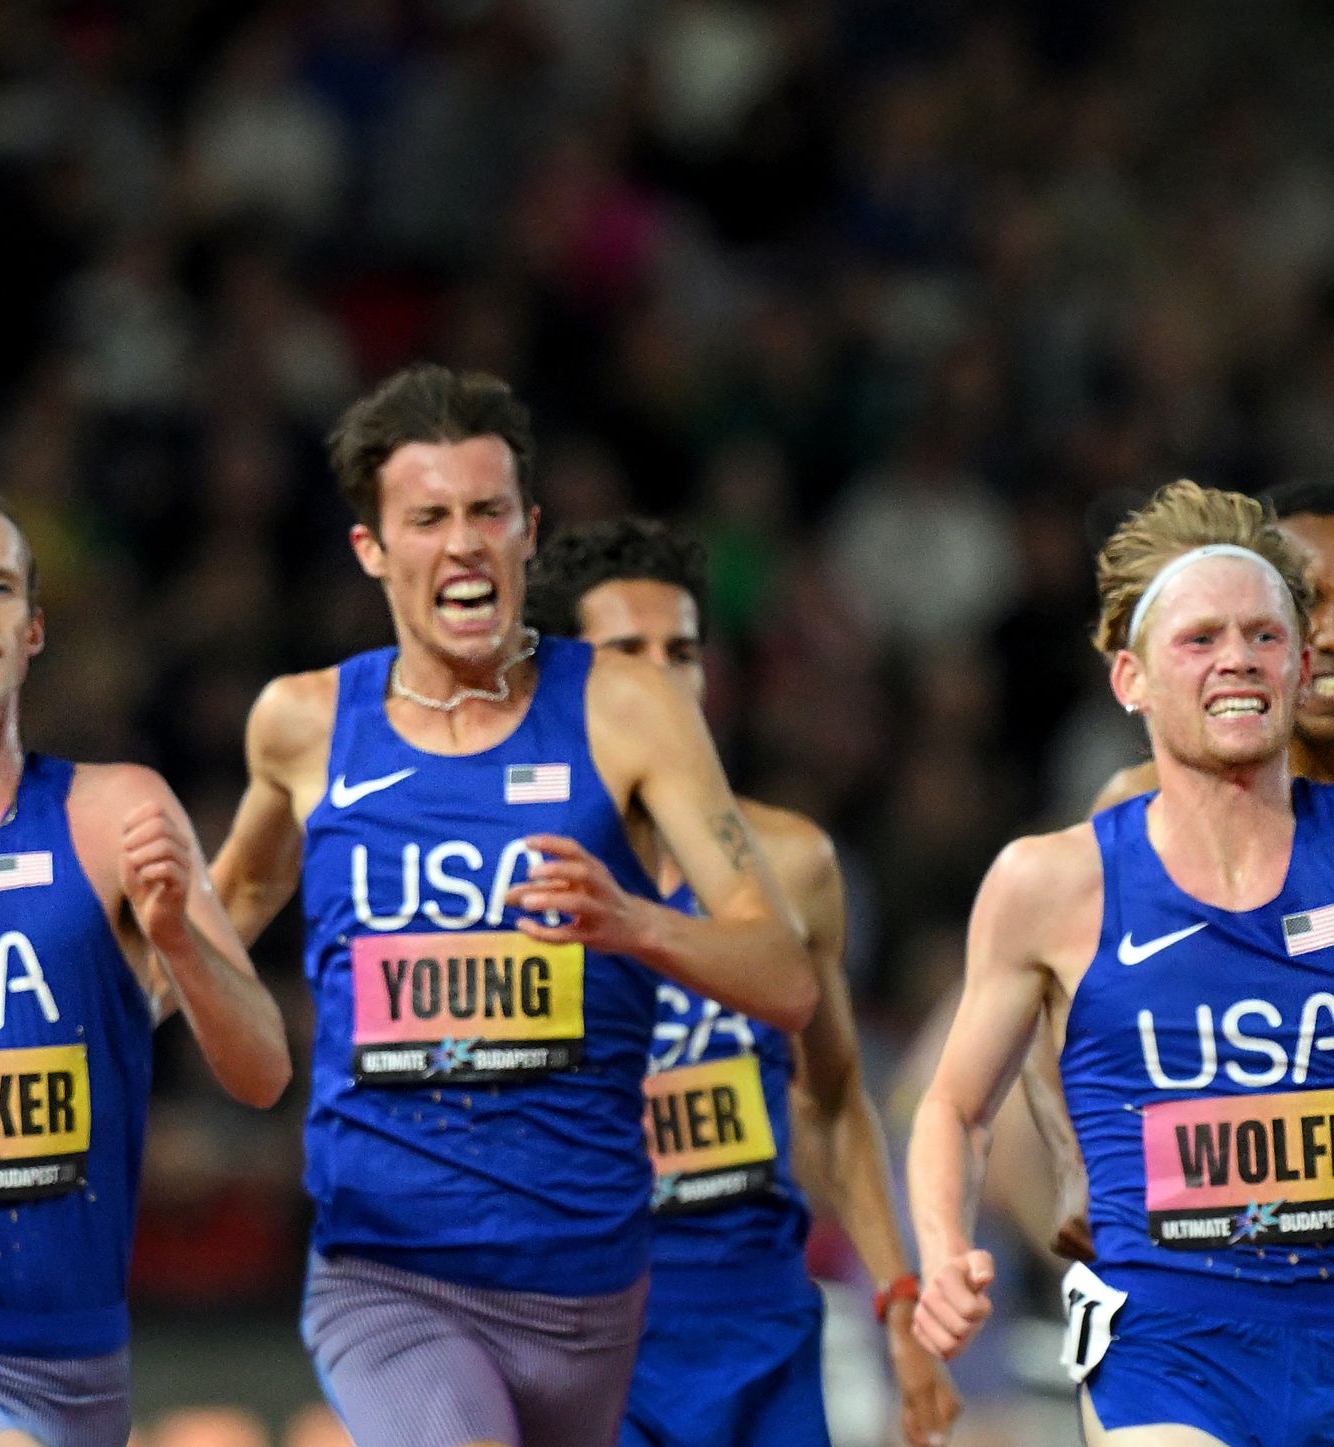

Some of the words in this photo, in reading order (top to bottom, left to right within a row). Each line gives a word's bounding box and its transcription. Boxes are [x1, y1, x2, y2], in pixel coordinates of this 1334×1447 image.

[351, 839, 563, 931] USA
[382, 957, 552, 1022] YOUNG
[649, 984, 756, 1076] SA
[645, 1085, 745, 1155] HER
[1161, 1217, 1231, 1240] ULTIMATE
